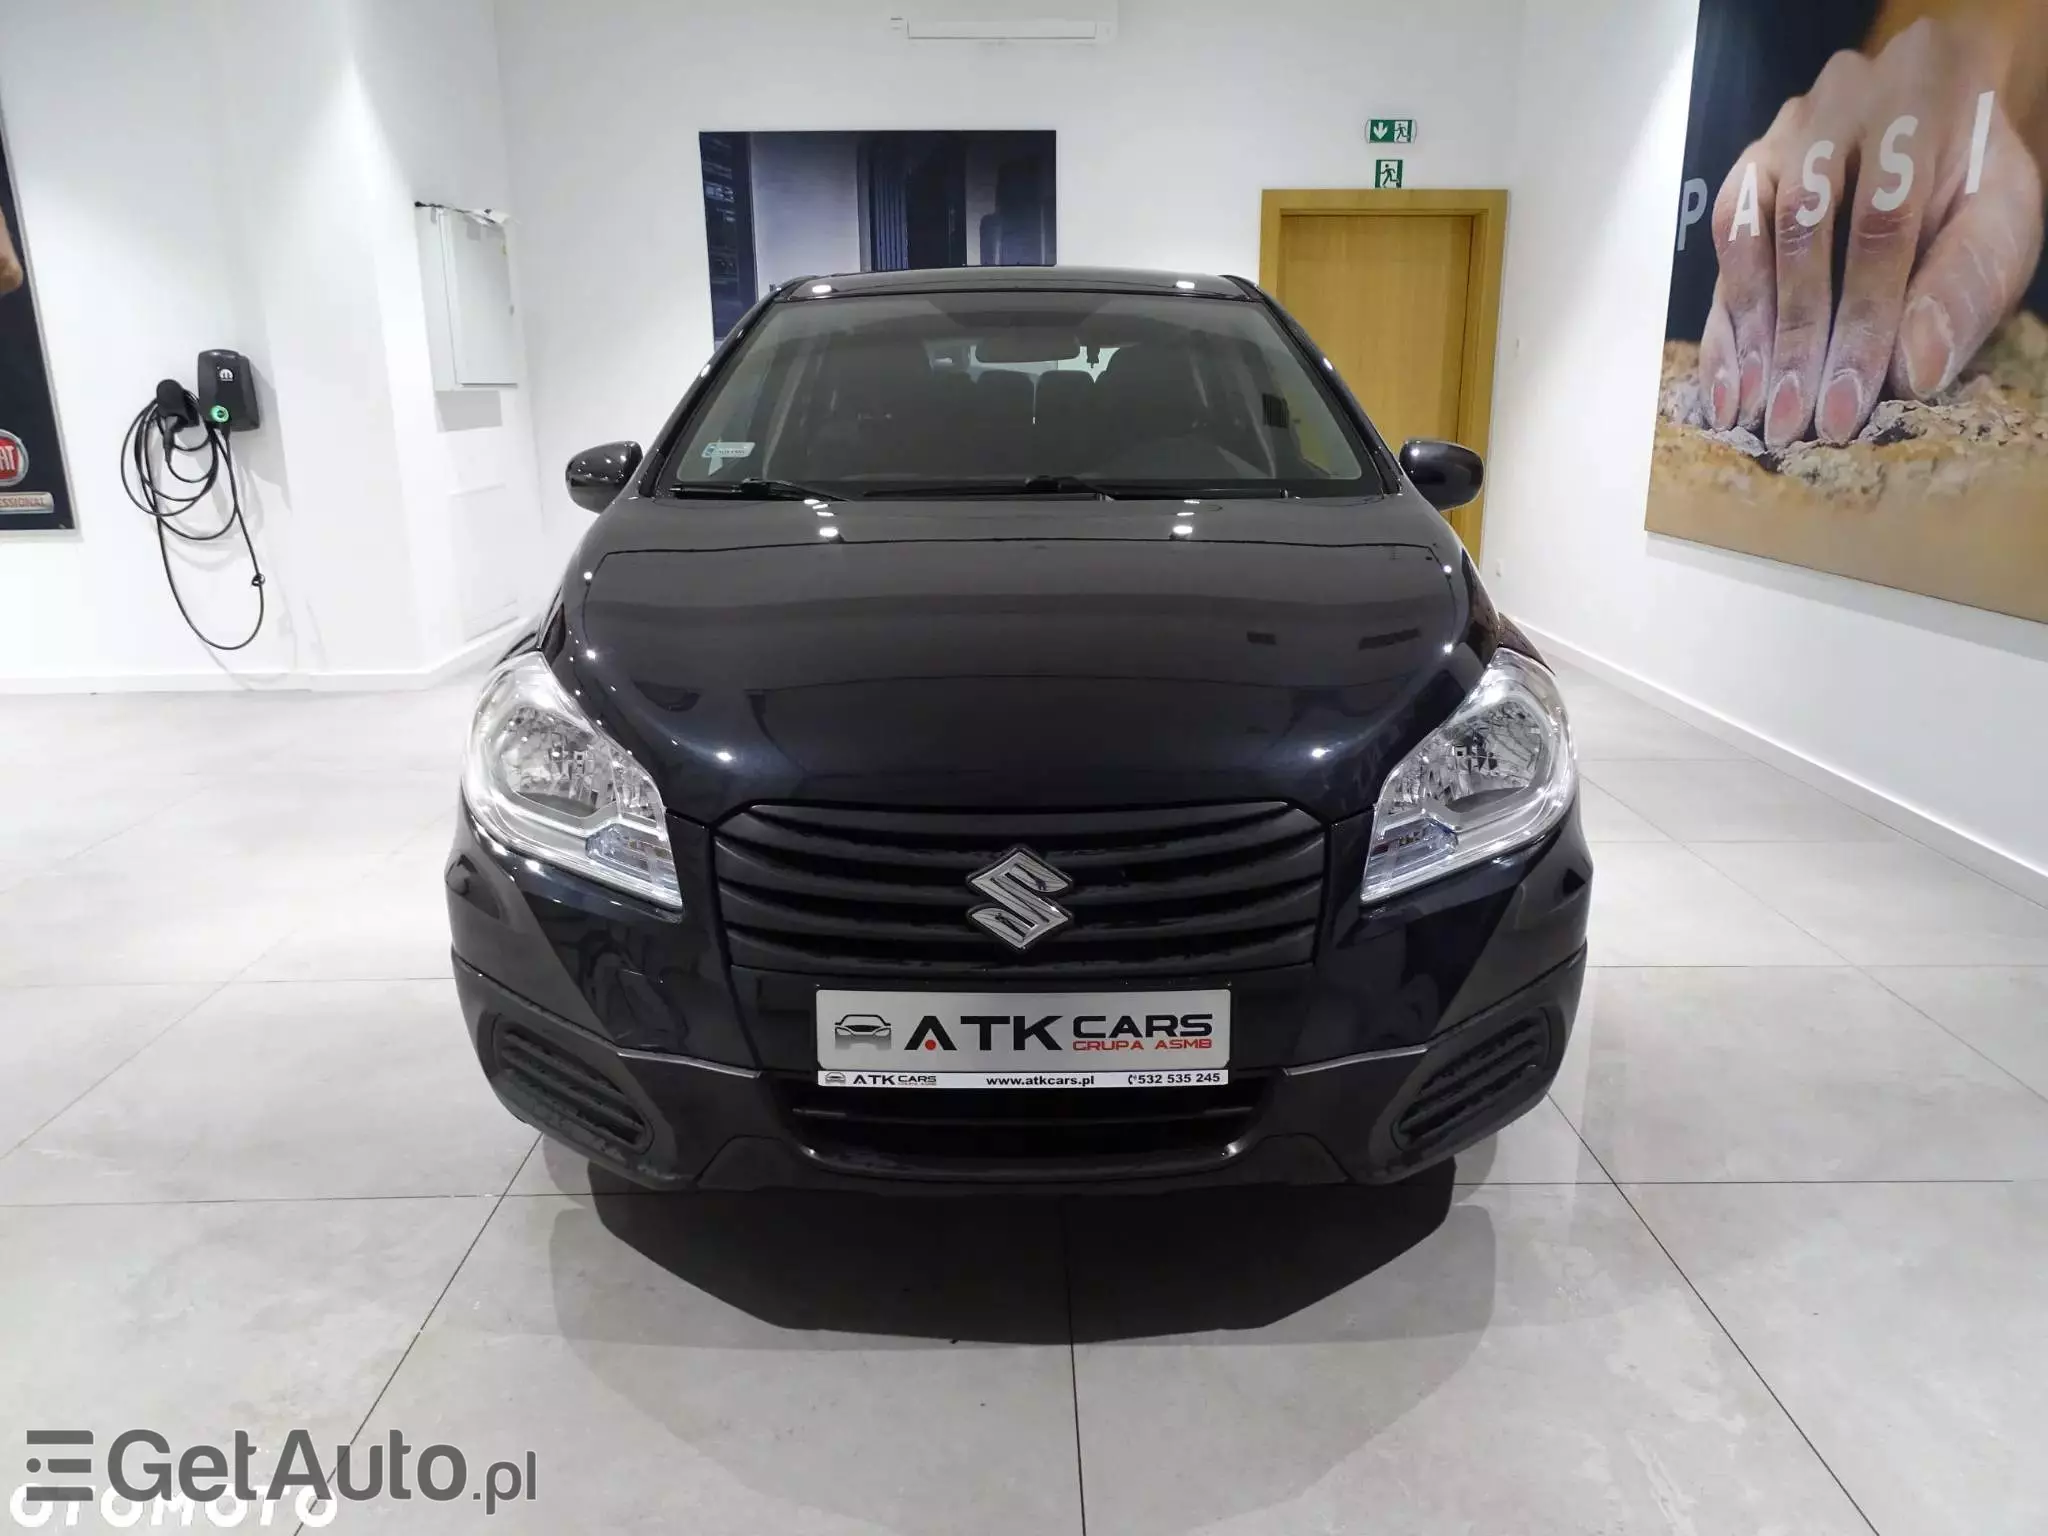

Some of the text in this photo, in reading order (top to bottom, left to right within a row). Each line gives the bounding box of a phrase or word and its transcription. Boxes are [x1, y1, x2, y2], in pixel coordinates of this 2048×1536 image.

[1677, 90, 1995, 251] PASSI
[904, 1013, 1213, 1051] ATK CARS
[1072, 1038, 1213, 1051] GRUPA ASMB
[853, 1074, 937, 1085] ATK CARS
[986, 1074, 1095, 1087] www.atkcars.pl
[1138, 1072, 1221, 1084] 532 535 245
